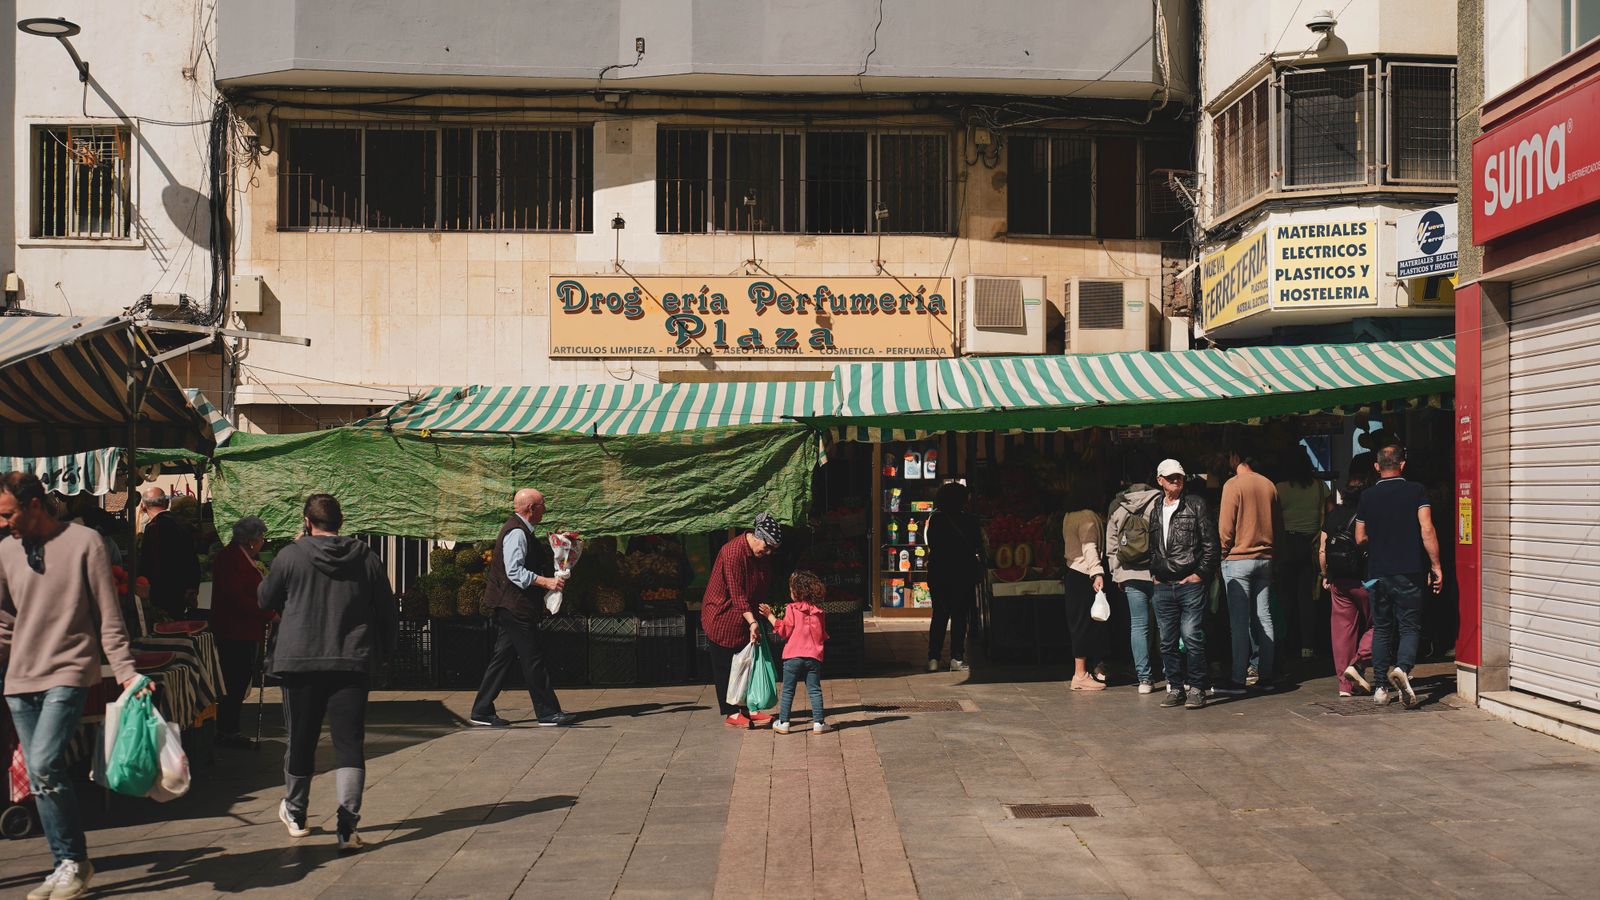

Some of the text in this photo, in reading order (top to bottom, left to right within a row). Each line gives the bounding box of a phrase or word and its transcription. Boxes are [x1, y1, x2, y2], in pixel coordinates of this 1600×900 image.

[1484, 122, 1566, 216] suma
[1277, 222, 1367, 240] MATERIALES
[1282, 243, 1367, 260] ELECTRICOS
[1203, 255, 1225, 280] NUEVA
[1400, 256, 1434, 268] MATERIALES
[1400, 264, 1429, 276] PLASTICOS
[1434, 260, 1458, 270] HOSTEL
[1204, 232, 1268, 327] FERRETERIA
[1275, 264, 1370, 281] PLASTICOS Y
[748, 281, 948, 317] Perfumería
[1280, 286, 1370, 302] HOSTELERIA
[665, 313, 834, 350] Plaza
[553, 346, 607, 354] ARTICULOS
[610, 346, 656, 354] LIMPIEZA
[667, 346, 712, 354] PLASTICO
[724, 346, 748, 354] ASEO
[820, 347, 875, 355] COSMETICA
[886, 347, 947, 355] PERFUMERIA
